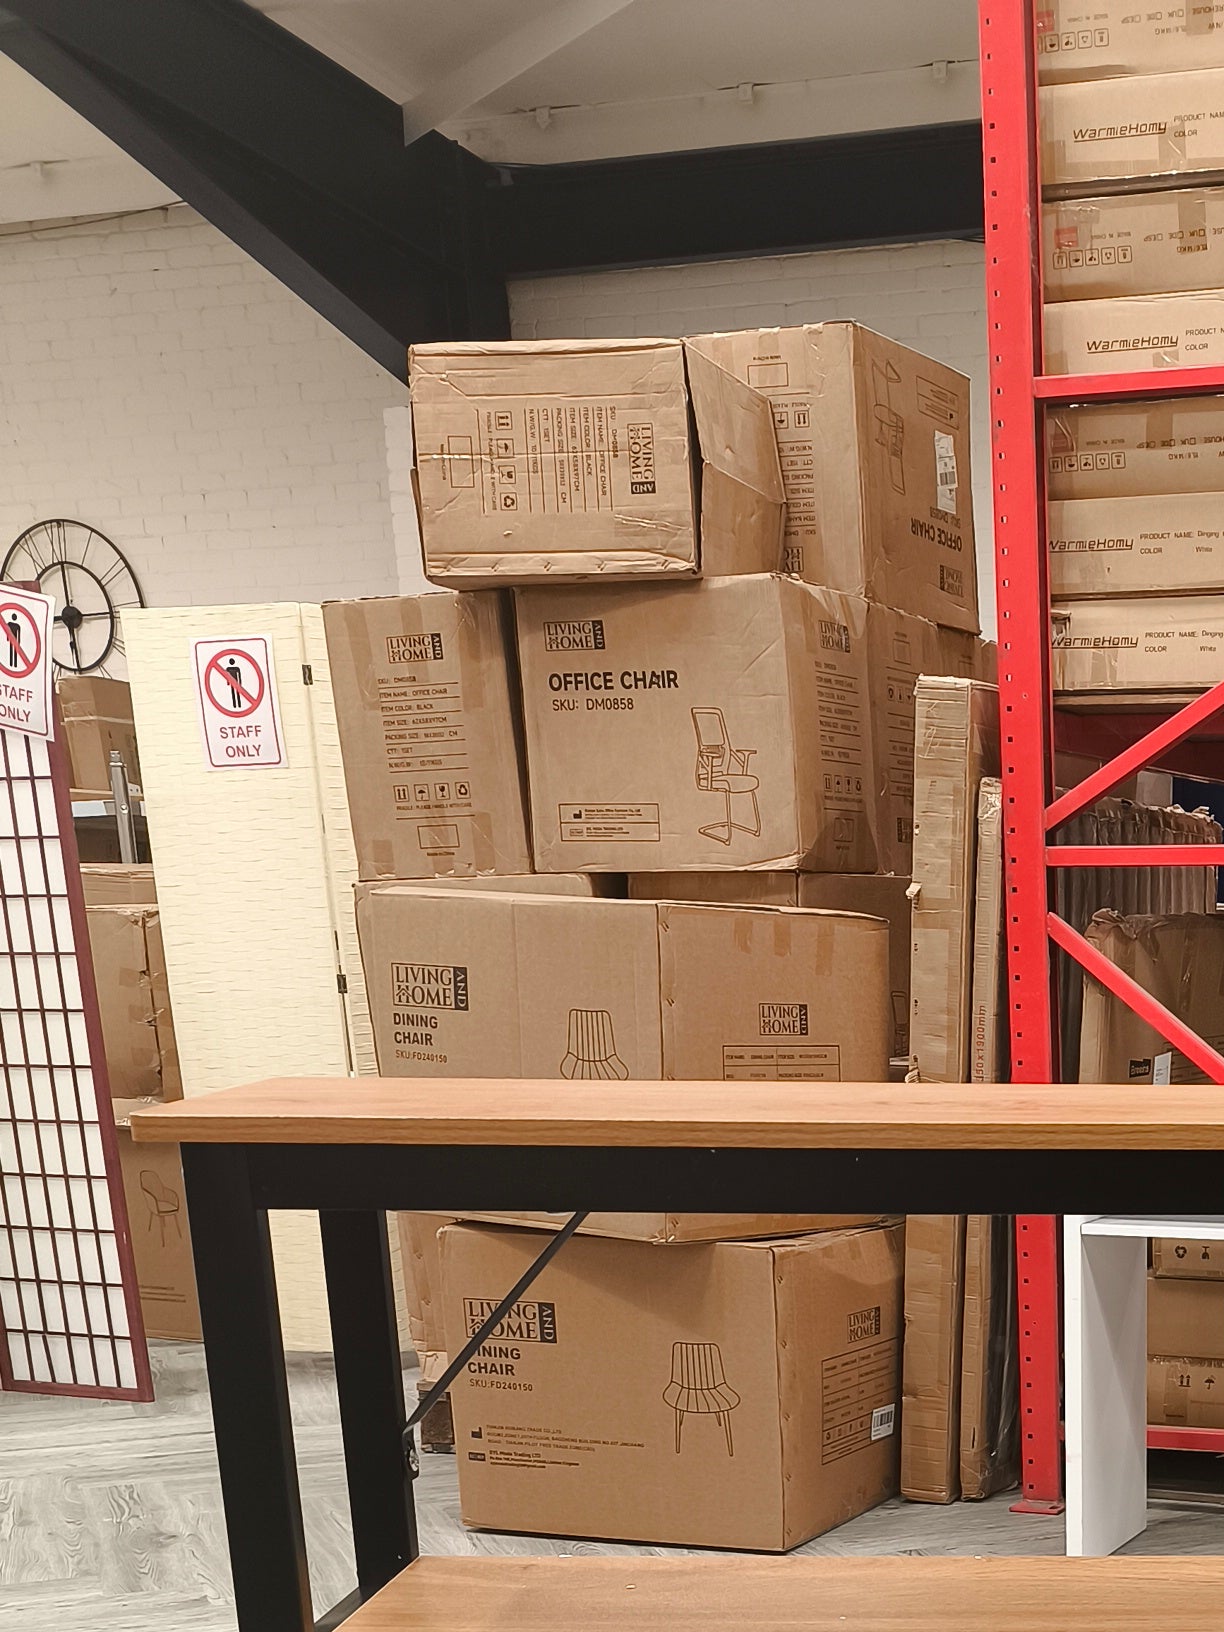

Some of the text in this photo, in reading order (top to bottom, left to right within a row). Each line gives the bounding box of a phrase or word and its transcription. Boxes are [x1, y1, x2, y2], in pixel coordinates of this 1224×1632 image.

[1073, 121, 1168, 140] WarmieHomy
[1185, 328, 1217, 336] PRODUCT
[1086, 335, 1179, 351] WarmieHomy
[630, 426, 642, 480] HOME
[641, 427, 654, 480] LIVING
[632, 485, 655, 493] AND
[911, 517, 962, 553] CHAIR OFFICE
[1140, 532, 1171, 540] PRODUCT
[546, 622, 592, 636] LIVING
[594, 625, 603, 648] AND
[1145, 630, 1175, 639] PRODUCT
[390, 635, 431, 649] LIVING
[433, 635, 442, 658] AND
[547, 635, 593, 649] HOME
[391, 647, 432, 662] HOME
[549, 669, 679, 692] OFFICE CHAIR
[552, 697, 634, 711] SKU: DM0858
[0, 705, 31, 723] ONLY
[219, 725, 262, 739] STAFF
[225, 744, 261, 758] ONLY
[395, 966, 452, 986] LIVING
[395, 984, 453, 1007] HOME
[456, 970, 467, 1008] AND
[761, 1005, 799, 1019] LIVING
[393, 1012, 438, 1029] DINING
[762, 1019, 799, 1034] HOME
[394, 1031, 434, 1047] CHAIR
[468, 1301, 537, 1320] LIVNG
[849, 1309, 875, 1327] LIVING
[542, 1306, 554, 1340] AND
[849, 1322, 875, 1342] HOME
[477, 1345, 521, 1360] INING
[467, 1361, 515, 1376] CHAIR
